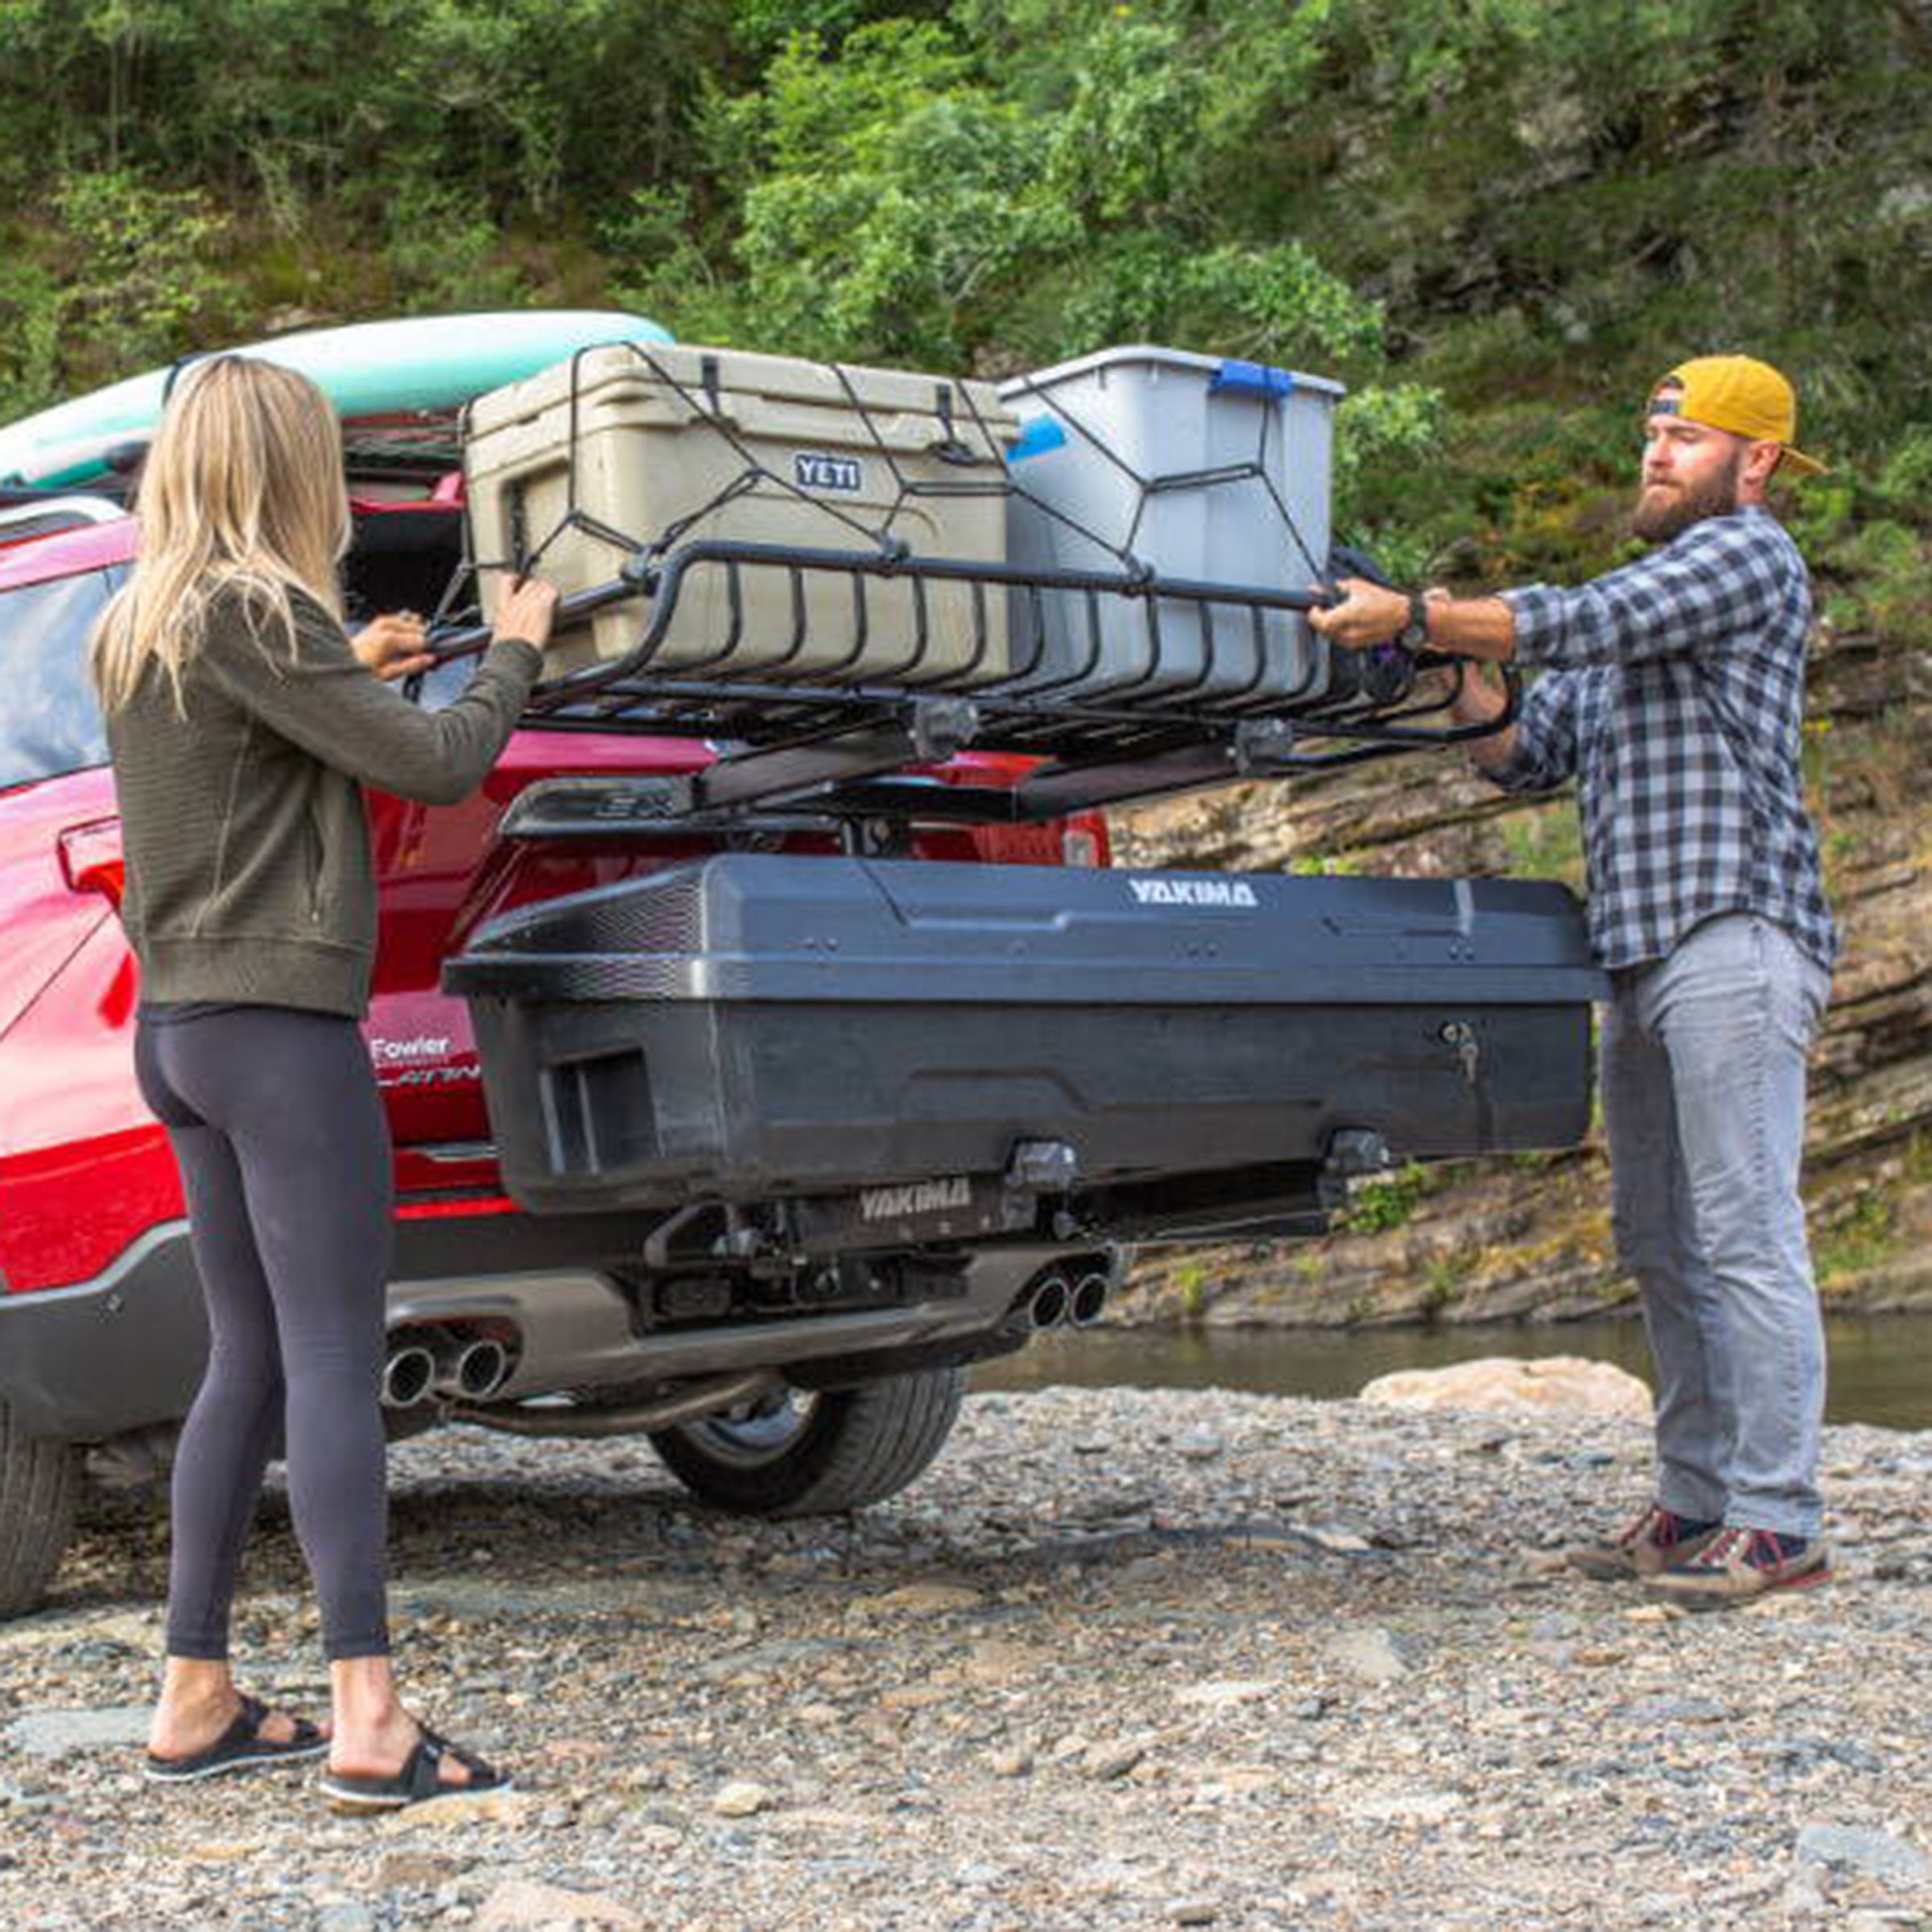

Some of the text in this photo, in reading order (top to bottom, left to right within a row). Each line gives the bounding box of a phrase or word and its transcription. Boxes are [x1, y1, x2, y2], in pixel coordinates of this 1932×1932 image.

[799, 459, 856, 487] YETI
[1129, 879, 1259, 907] YAKIMA
[369, 1035, 450, 1059] Fowler
[861, 1178, 972, 1221] YAKIMA
